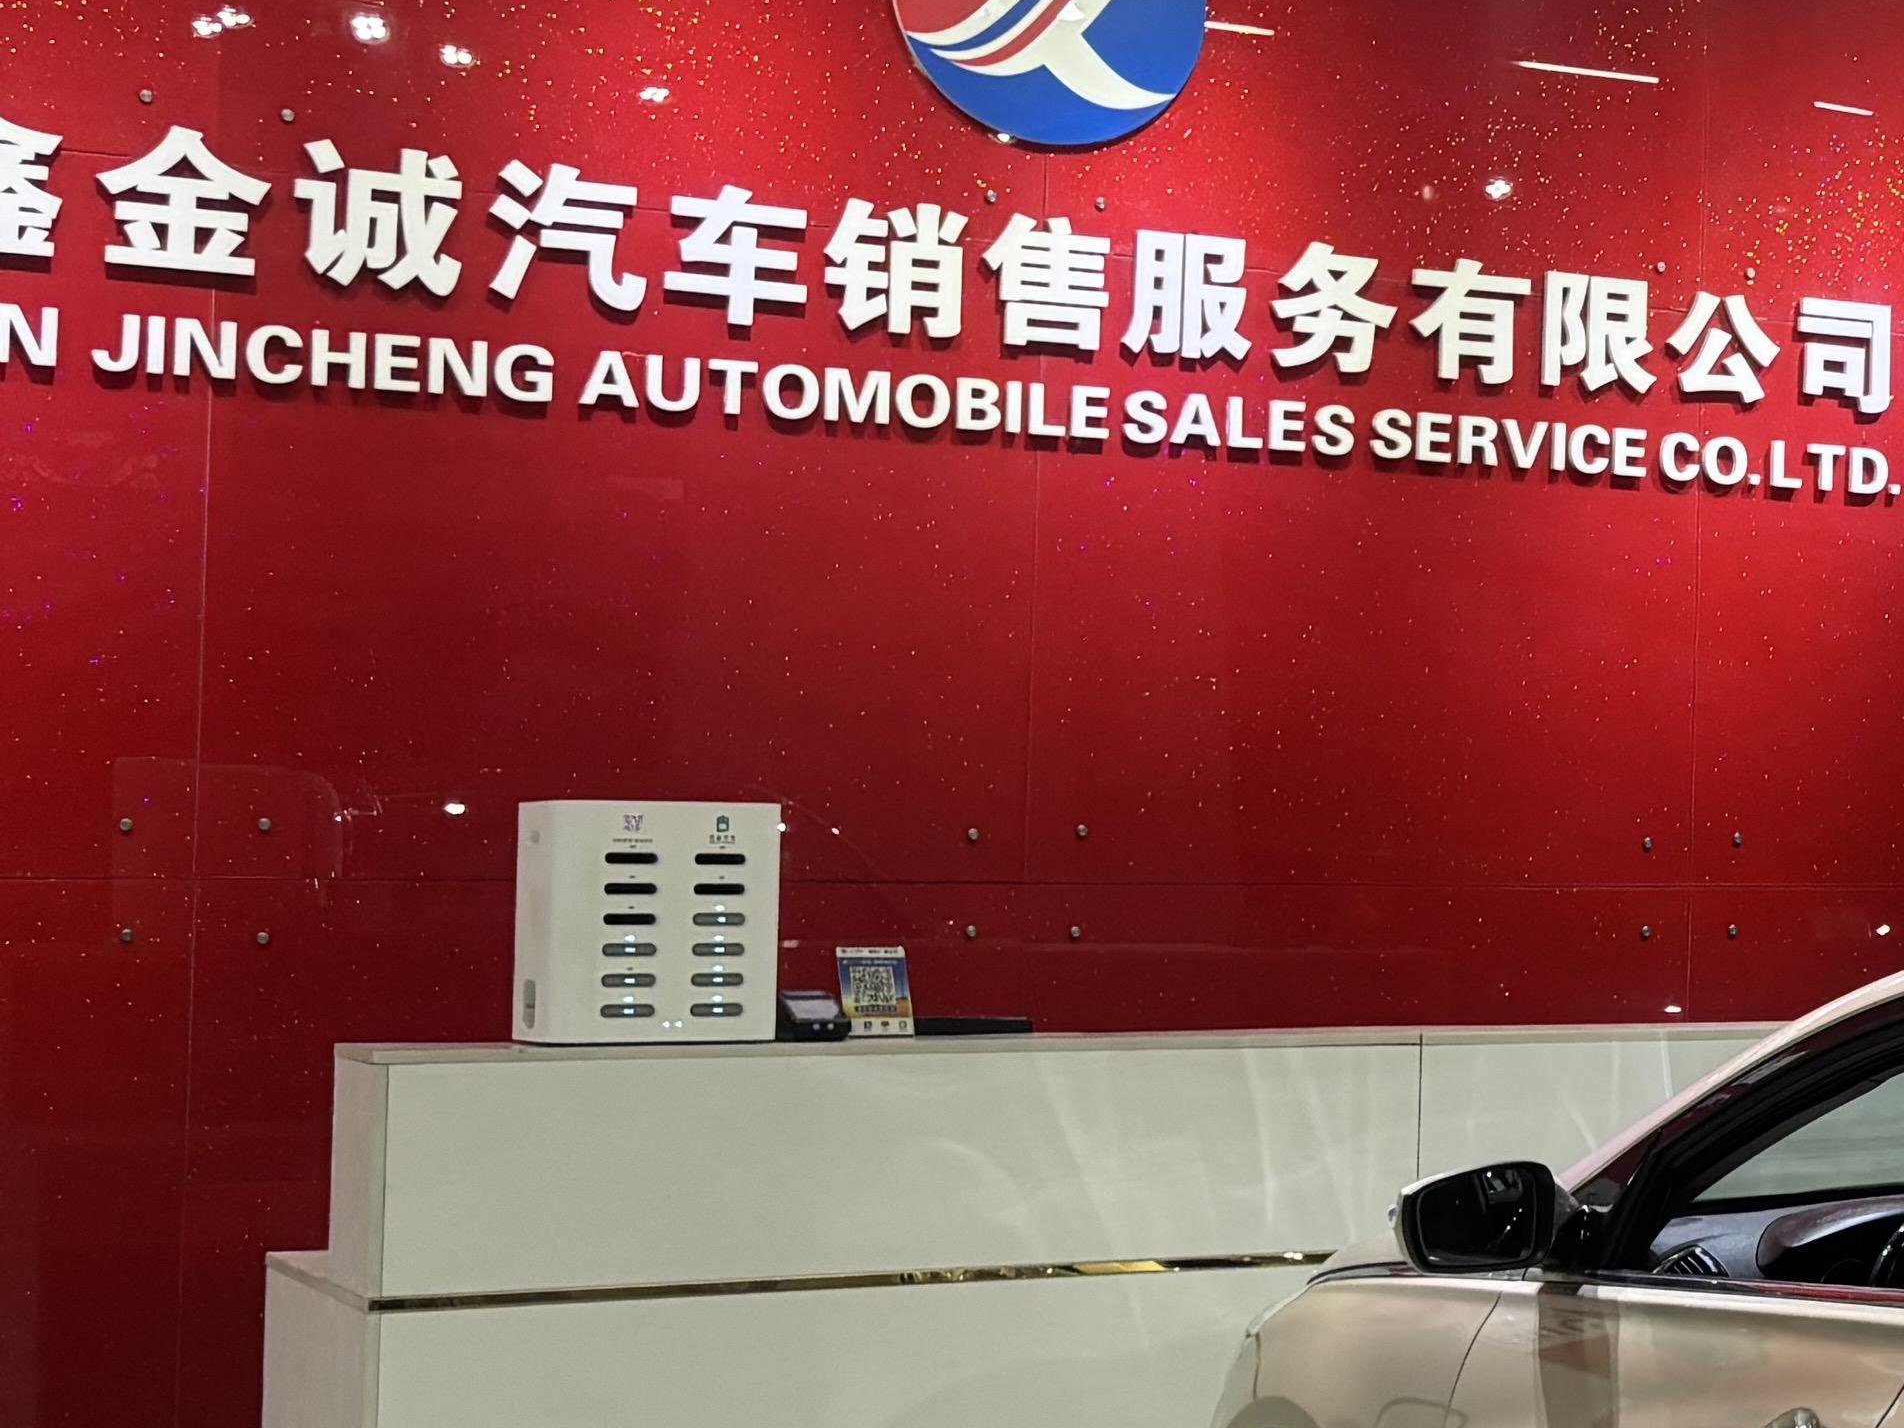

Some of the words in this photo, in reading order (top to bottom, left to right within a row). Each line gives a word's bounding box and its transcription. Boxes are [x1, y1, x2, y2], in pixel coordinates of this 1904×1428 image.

[92, 310, 555, 403] JINCHENG
[580, 349, 1109, 440] AUTOMOBILE
[1124, 389, 1356, 456] SALES
[1370, 408, 1647, 478] SERVICE
